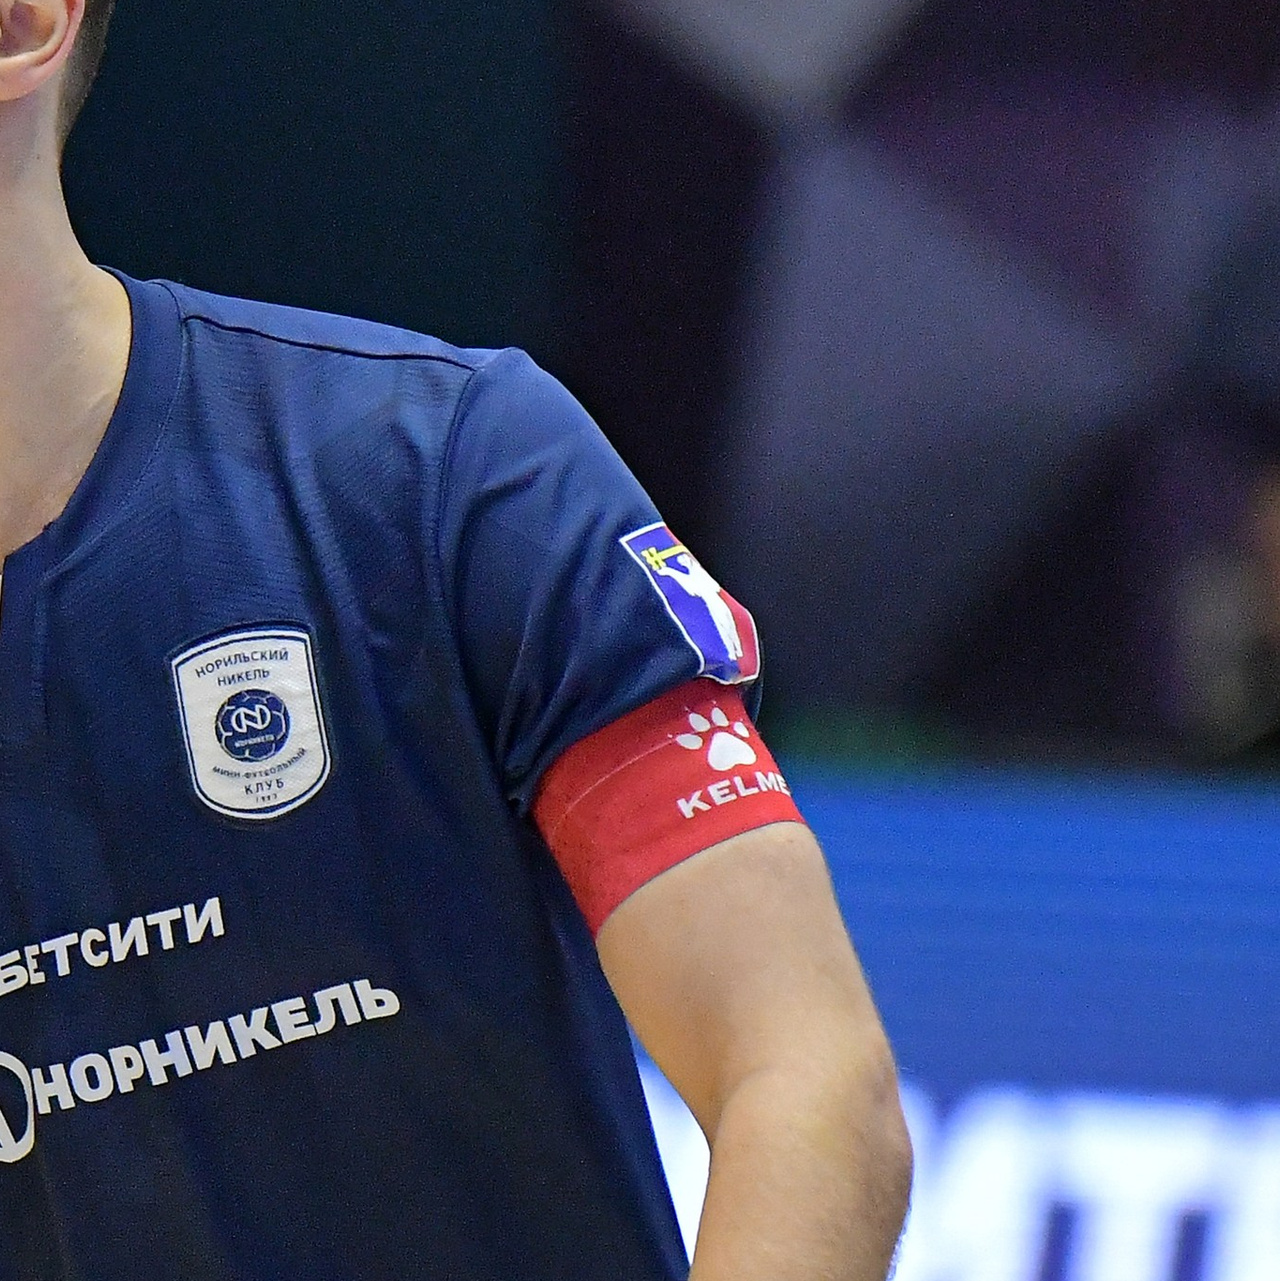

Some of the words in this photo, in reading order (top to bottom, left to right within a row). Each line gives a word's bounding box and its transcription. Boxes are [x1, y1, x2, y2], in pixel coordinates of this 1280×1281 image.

[194, 646, 290, 679] НОРИЛЬСКИЙ
[217, 668, 270, 687] НИКЕЛЬ
[244, 778, 285, 796] КЛУБ
[676, 770, 792, 820] KELME
[31, 978, 402, 1115] НОРНИКЕЛЬ
